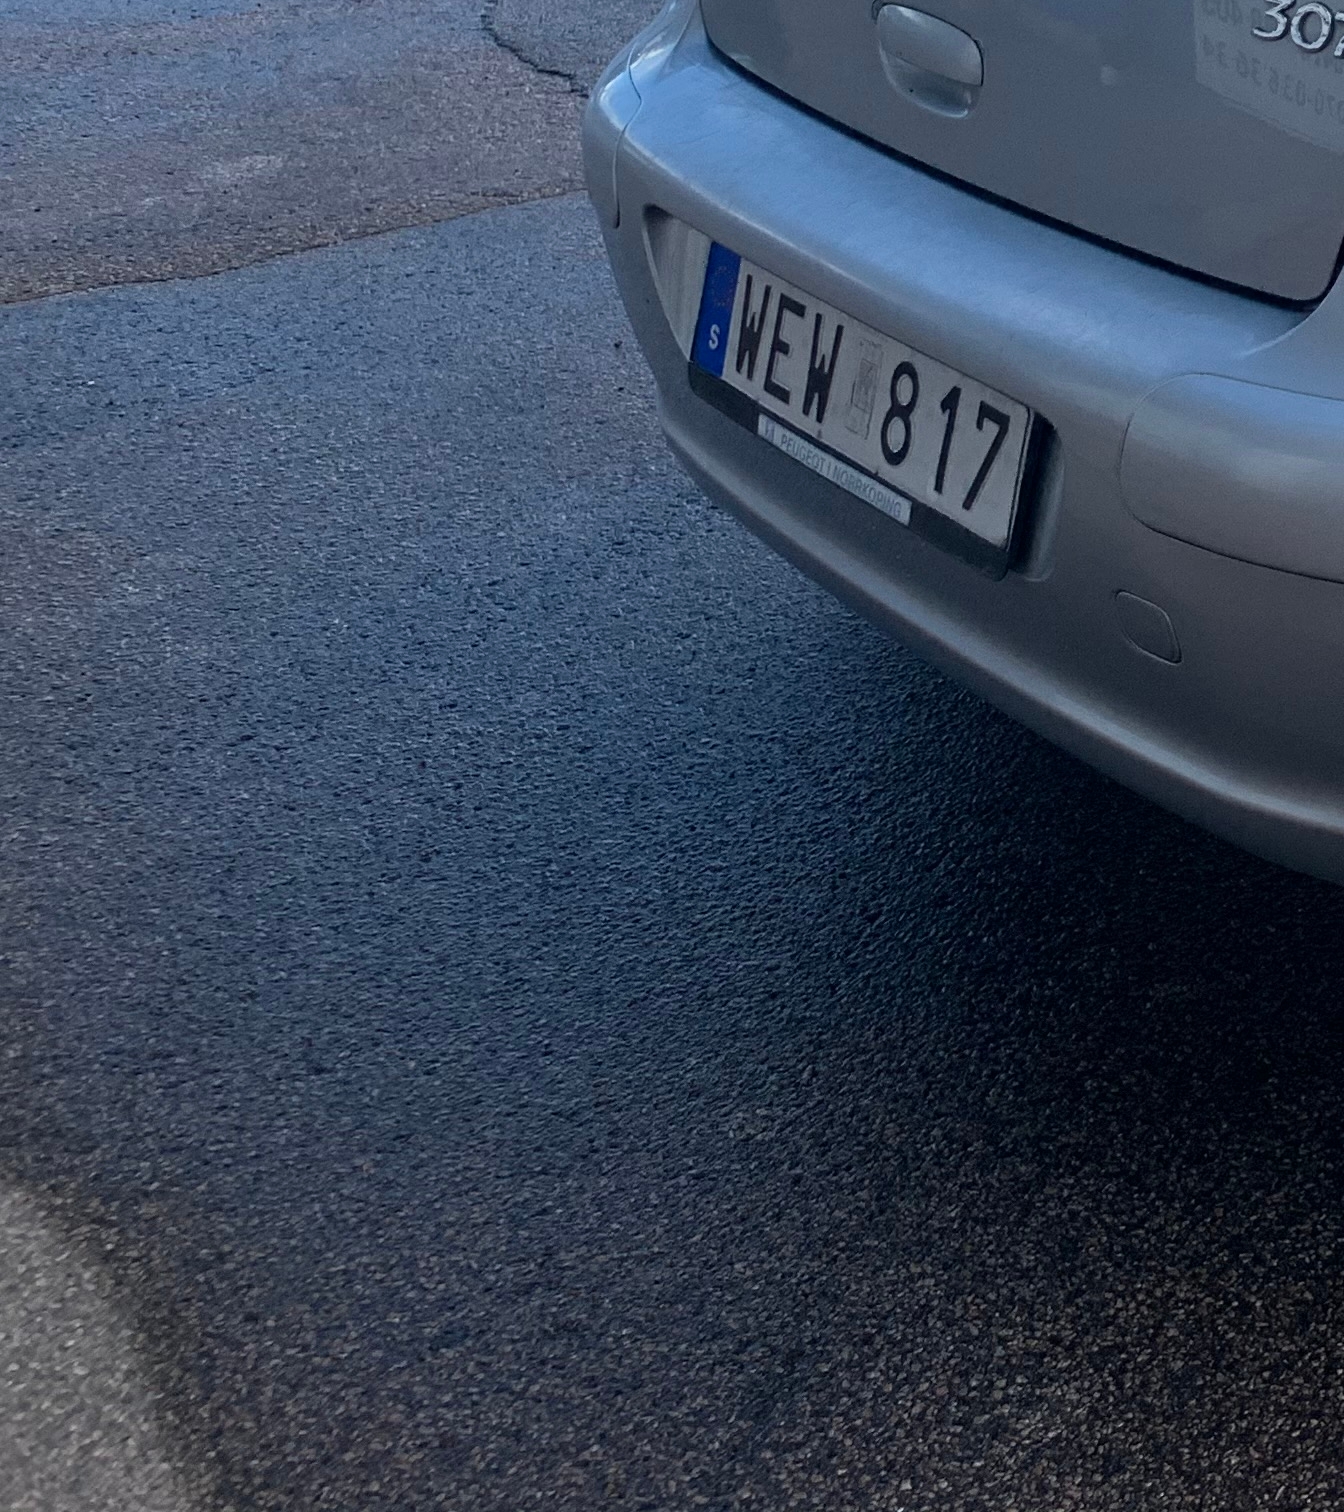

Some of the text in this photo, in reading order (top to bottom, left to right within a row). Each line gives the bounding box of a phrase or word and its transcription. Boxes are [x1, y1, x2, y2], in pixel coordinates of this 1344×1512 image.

[708, 323, 721, 350] S
[736, 274, 1011, 511] WEW 817
[781, 432, 827, 475] PEUGEOT
